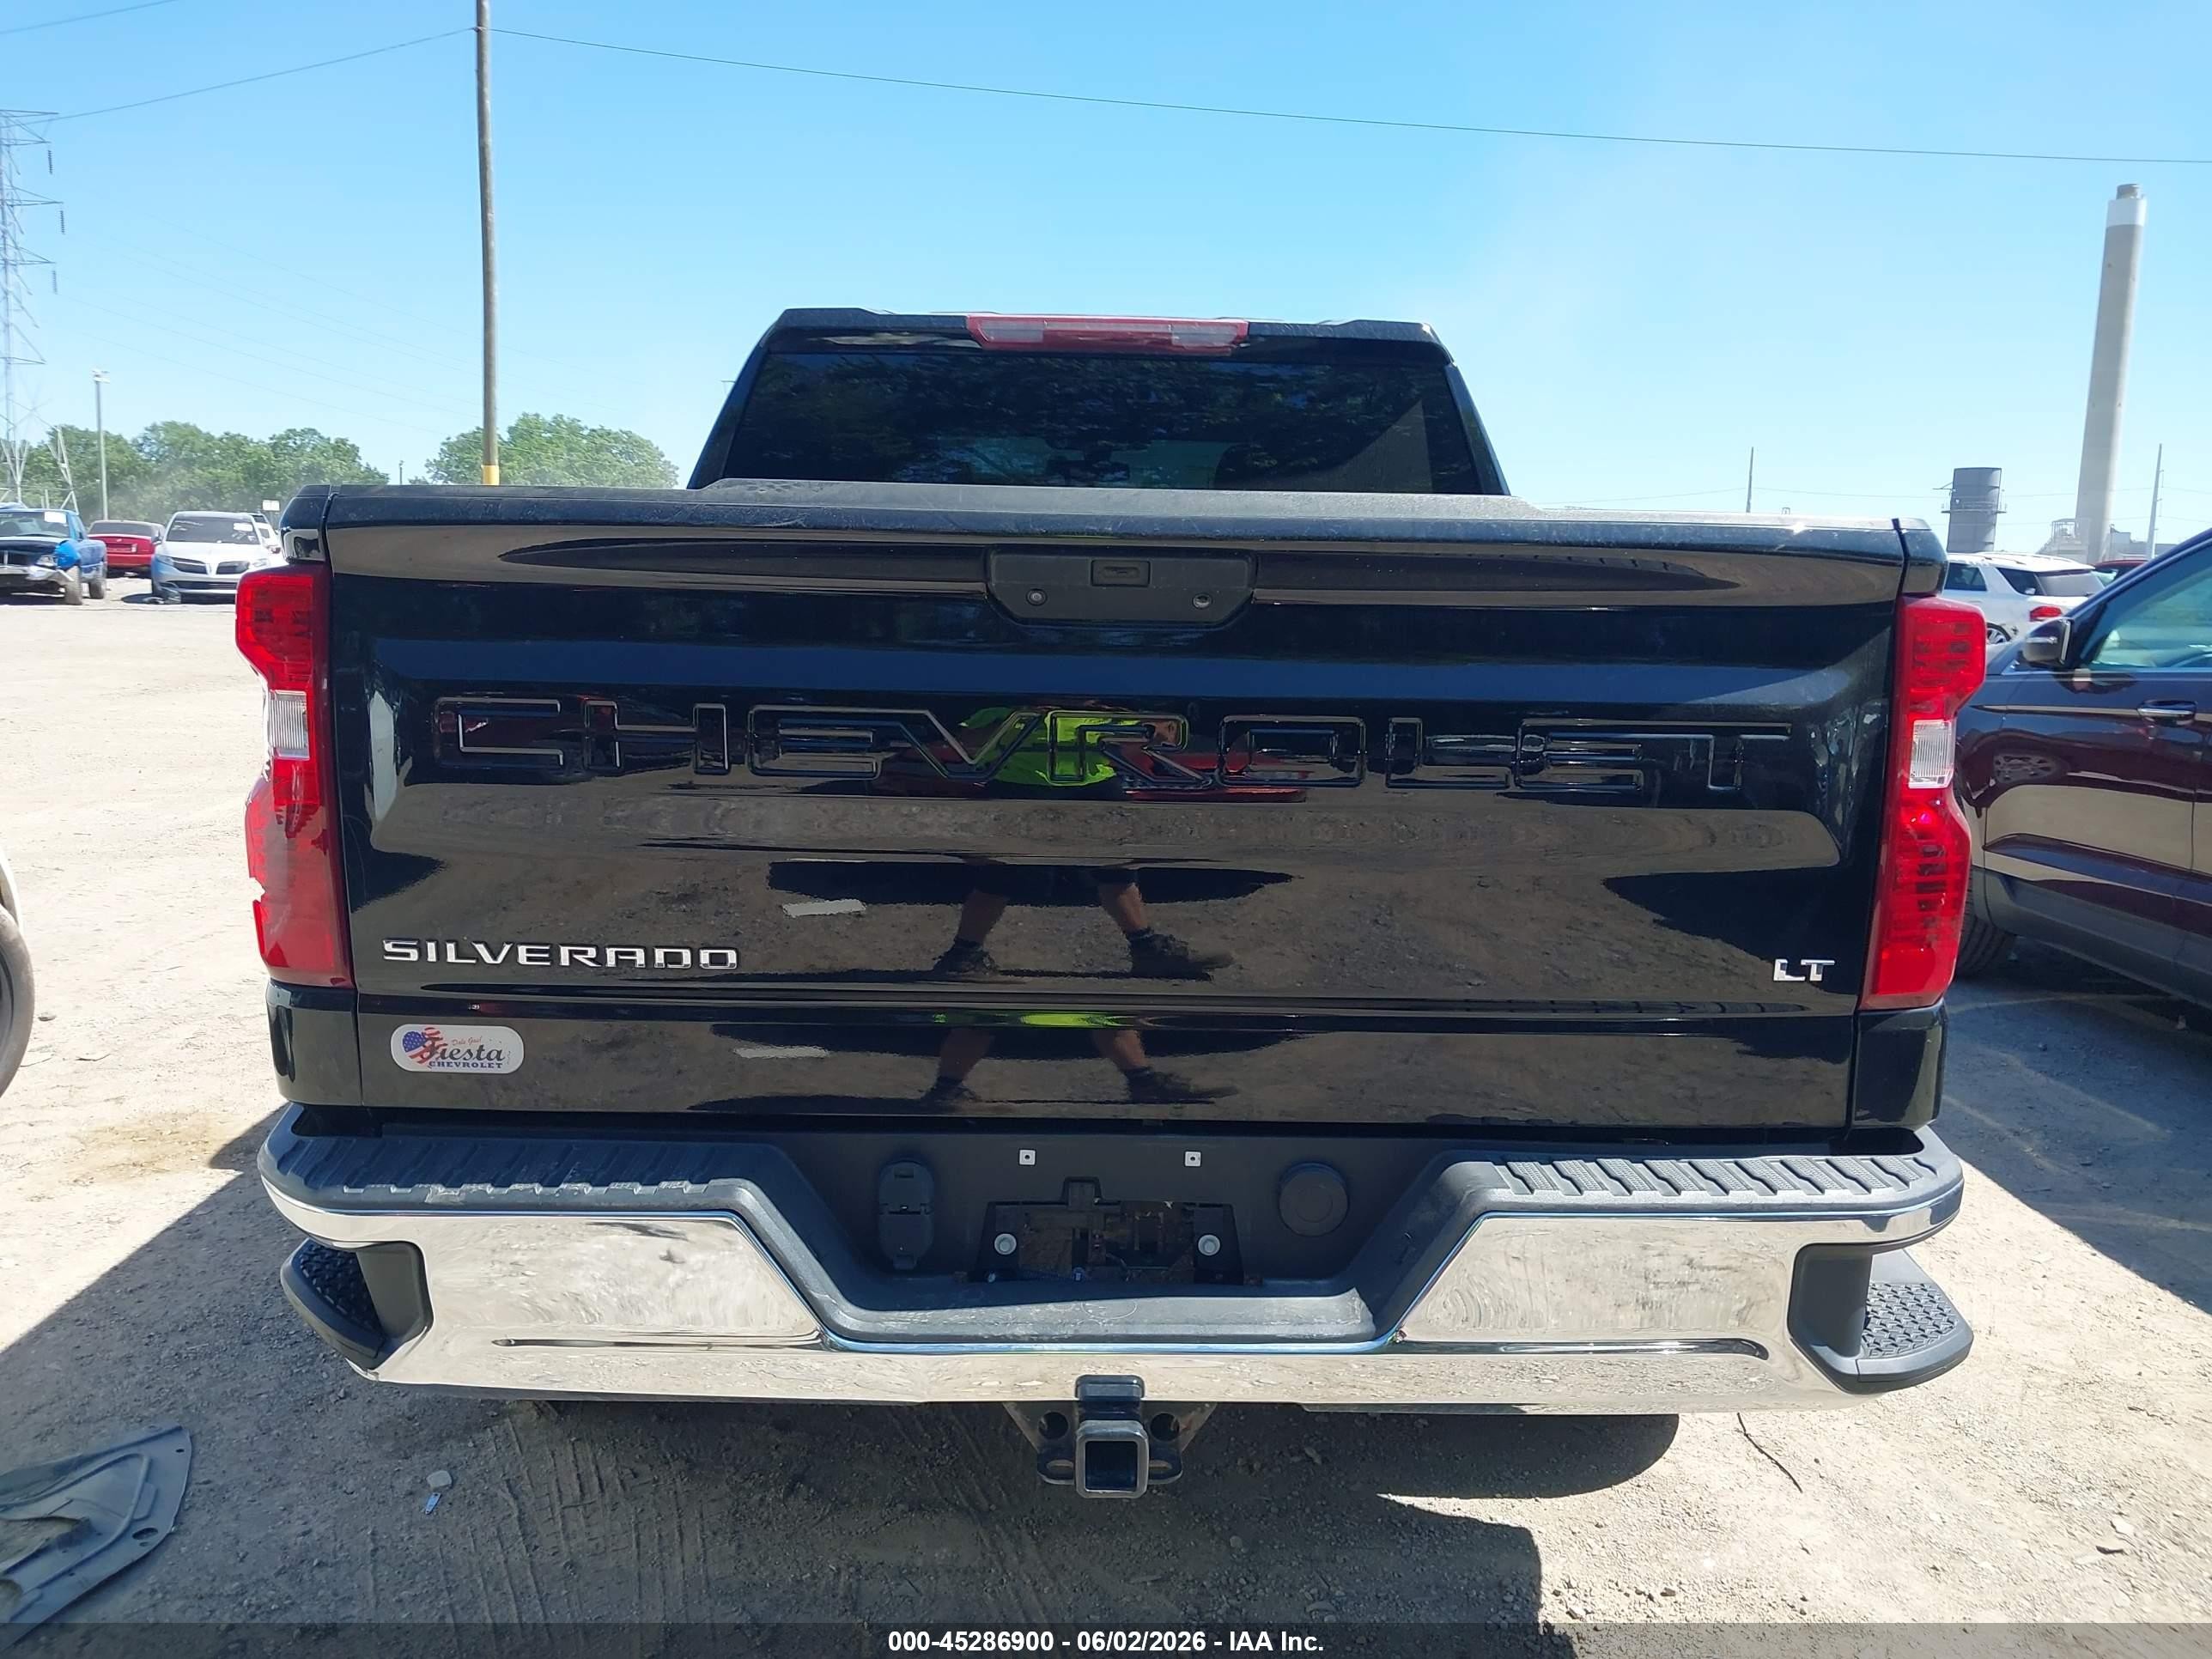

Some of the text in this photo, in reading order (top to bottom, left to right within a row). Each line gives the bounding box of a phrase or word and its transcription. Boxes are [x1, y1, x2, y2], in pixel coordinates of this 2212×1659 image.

[434, 696, 1792, 791] CHEVROLET
[382, 939, 738, 969] SILVERADO
[1773, 958, 1836, 981] LT
[428, 1060, 503, 1069] CHEVROLET
